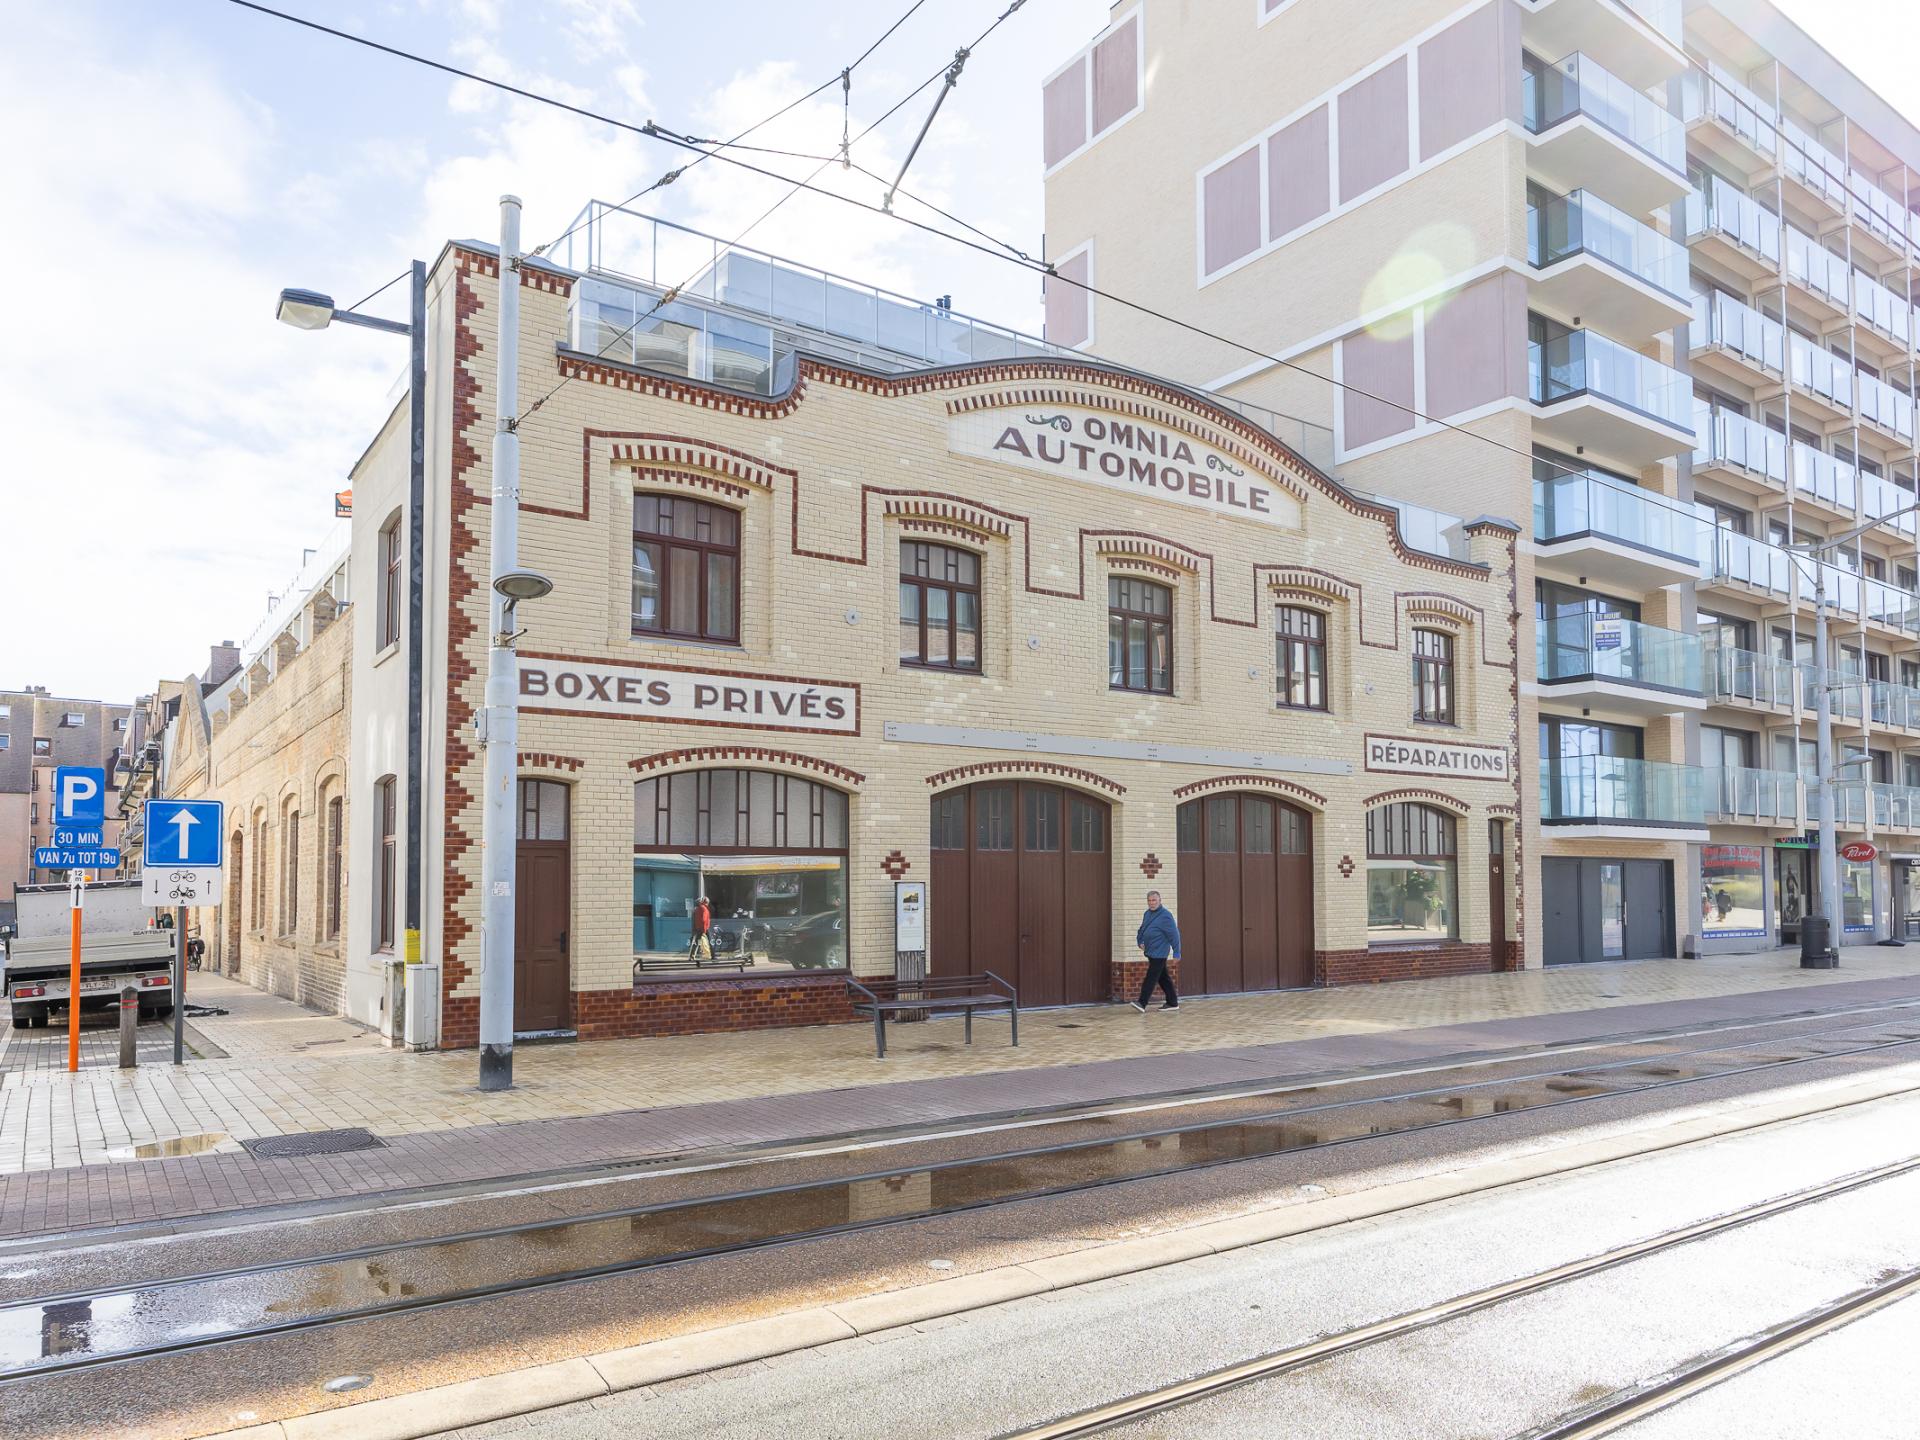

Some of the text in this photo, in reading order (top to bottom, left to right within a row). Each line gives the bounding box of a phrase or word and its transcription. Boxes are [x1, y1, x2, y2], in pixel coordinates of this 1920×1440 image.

[1083, 417, 1196, 465] OMNIA
[992, 426, 1270, 514] AUTOMOBILE
[518, 668, 846, 720] BOXES PRIVÉS
[1371, 741, 1504, 772] RÉPARATIONS
[62, 775, 98, 817] P
[38, 851, 116, 865] VAN 7u TOT 19u
[57, 832, 73, 844] 30
